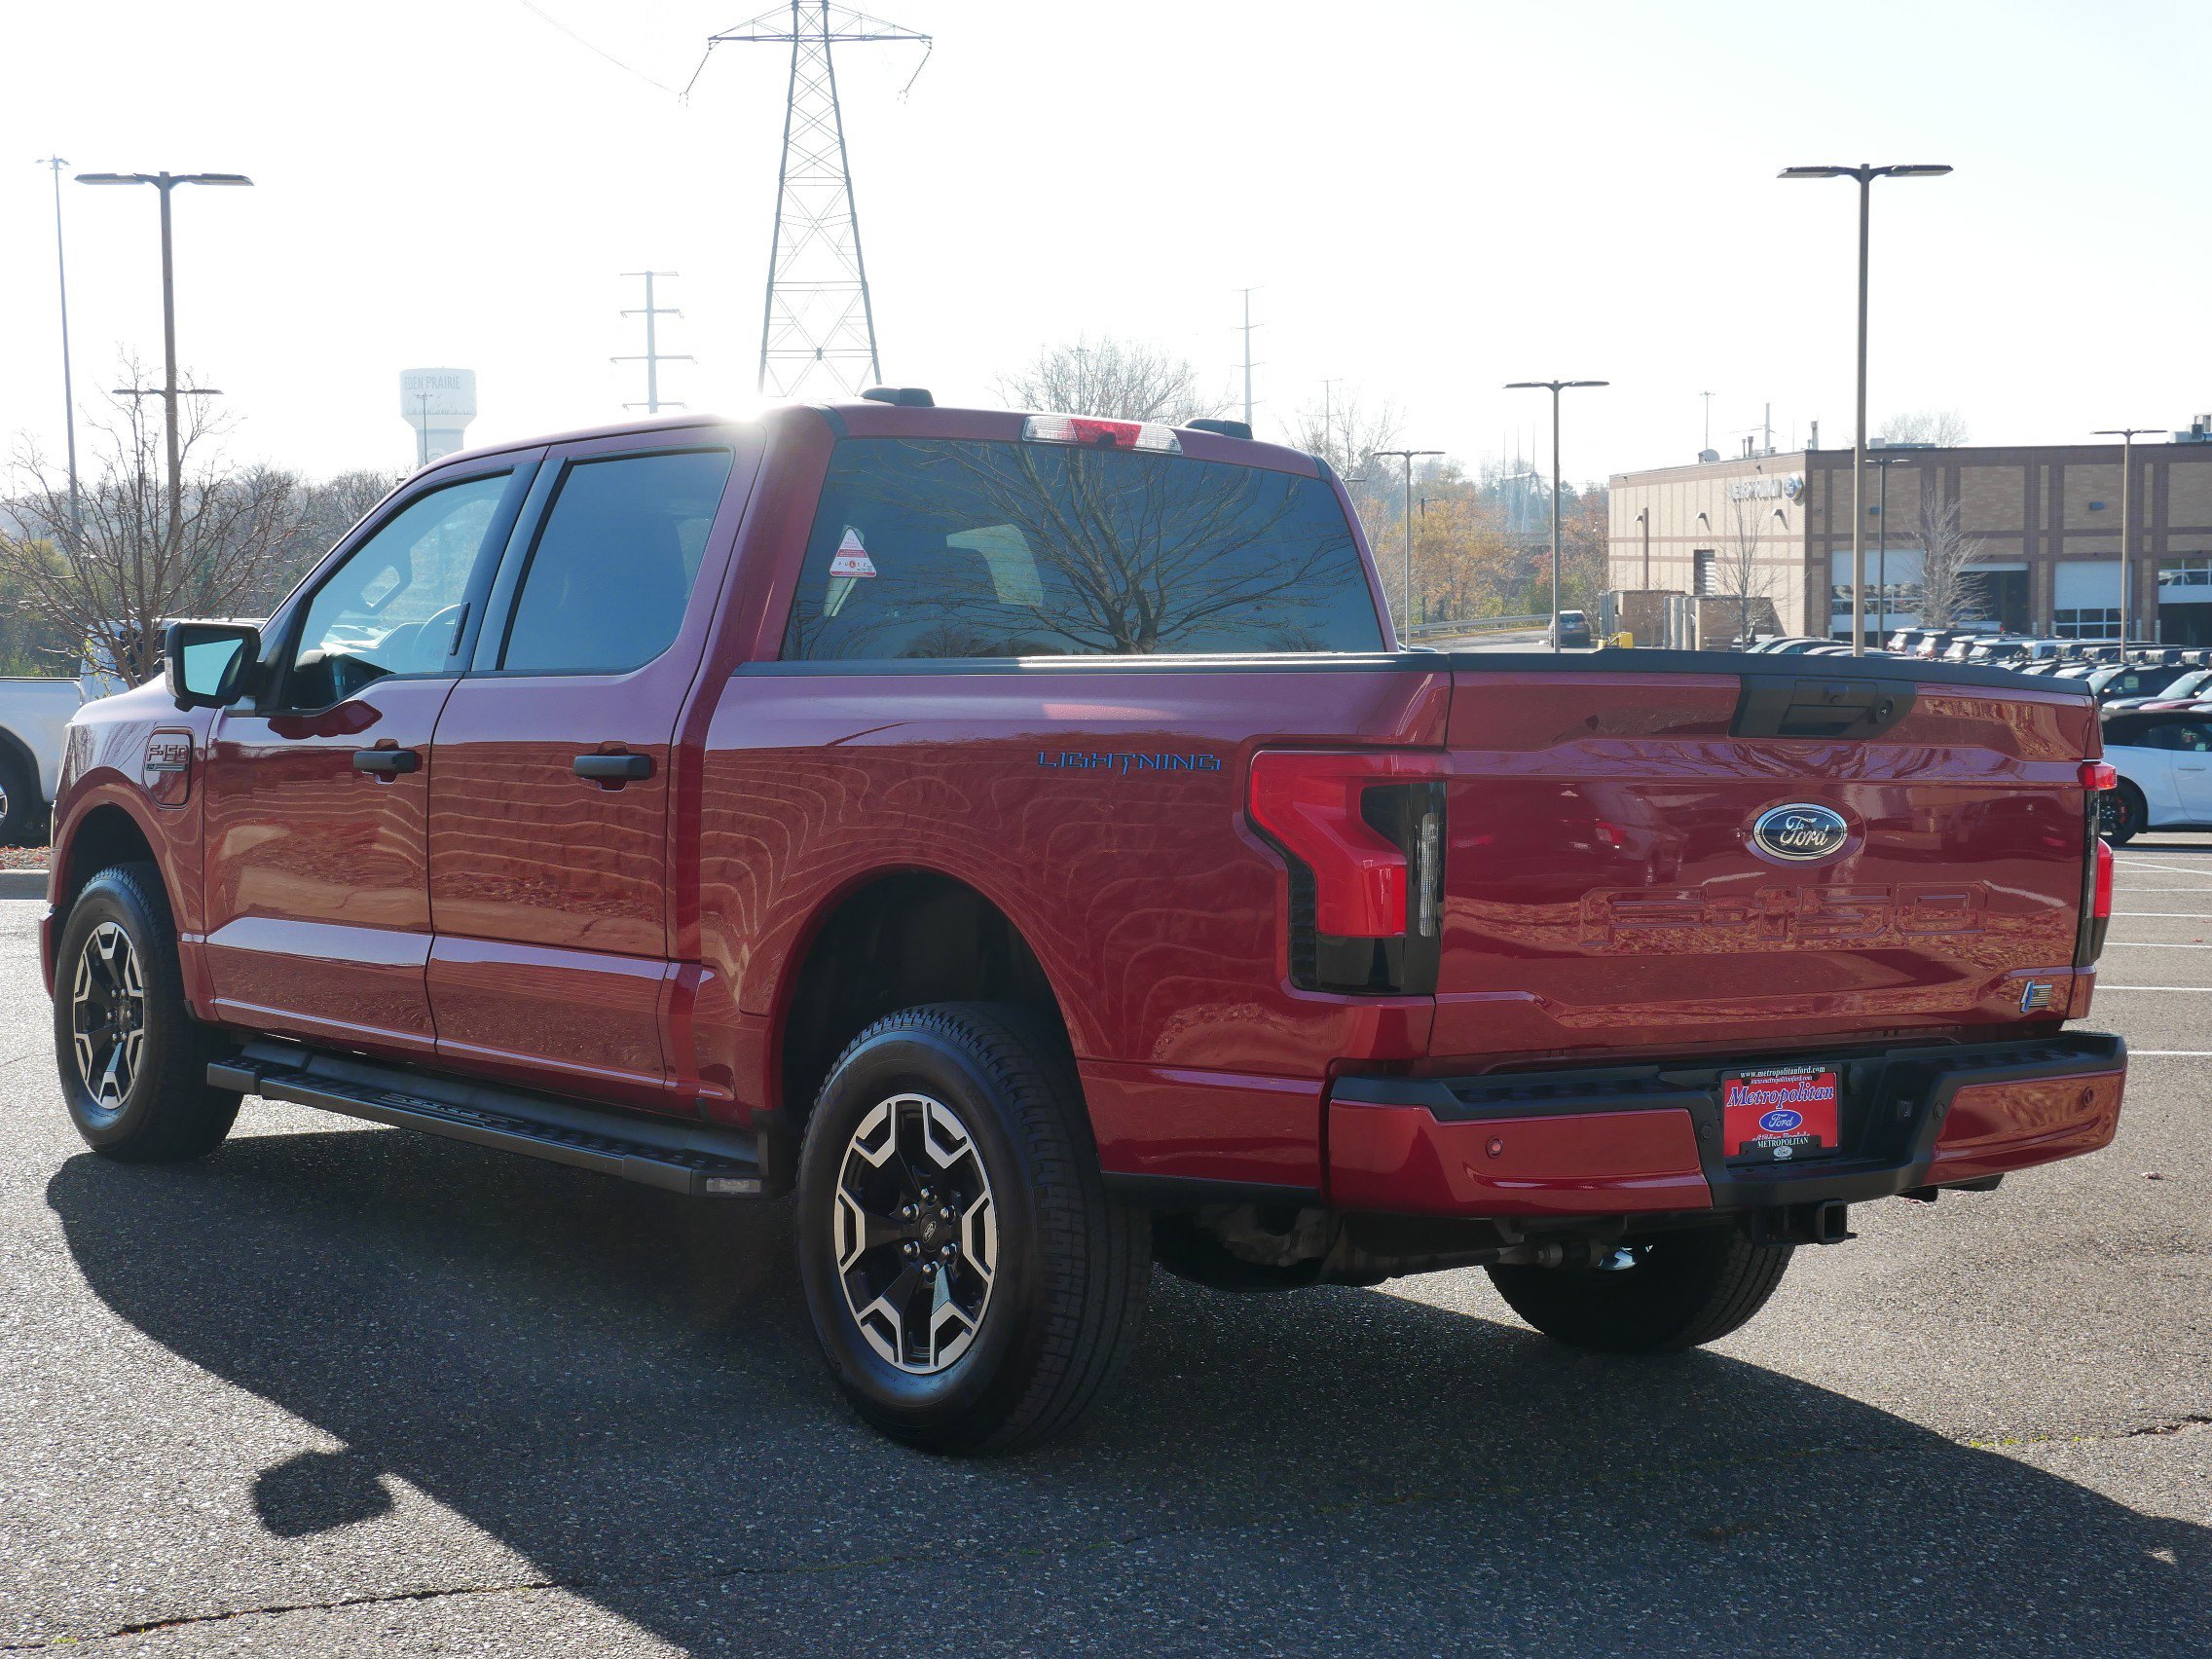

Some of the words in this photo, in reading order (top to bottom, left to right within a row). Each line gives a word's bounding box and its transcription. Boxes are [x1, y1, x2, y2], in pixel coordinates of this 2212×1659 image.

[404, 376, 424, 389] EDEN
[425, 376, 461, 389] PRAIRIE
[1038, 752, 1222, 775] LIGHTNING
[1779, 815, 1830, 846] Ford
[1579, 882, 1990, 946] F-150
[1740, 1065, 1826, 1079] www.metropolitanford.com
[1726, 1082, 1834, 1110] Metropolitan
[1768, 1113, 1794, 1127] Ford
[1756, 1136, 1809, 1149] METROPOLITAN
